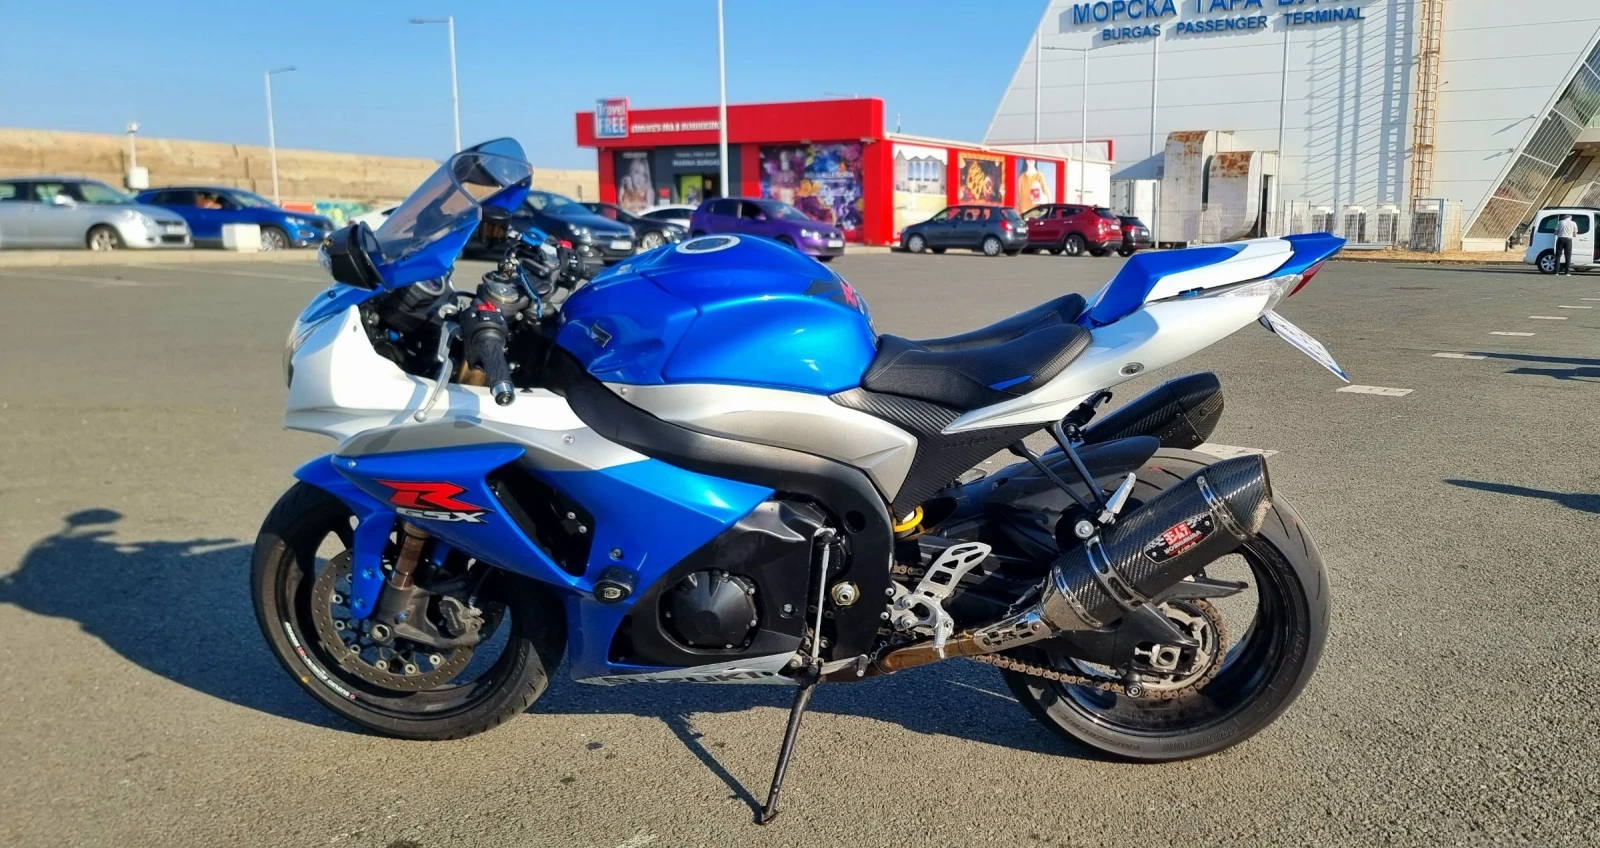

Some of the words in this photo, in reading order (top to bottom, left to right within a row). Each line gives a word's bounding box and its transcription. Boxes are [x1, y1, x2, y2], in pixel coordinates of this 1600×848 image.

[1073, 0, 1178, 24] МОРСКА
[1102, 25, 1161, 40] BURGAS
[1176, 16, 1268, 34] PASSENGER
[1284, 7, 1366, 25] TERMINAL
[597, 101, 626, 116] Travel
[598, 117, 626, 133] FREE
[375, 479, 483, 511] R
[396, 507, 486, 523] GSX
